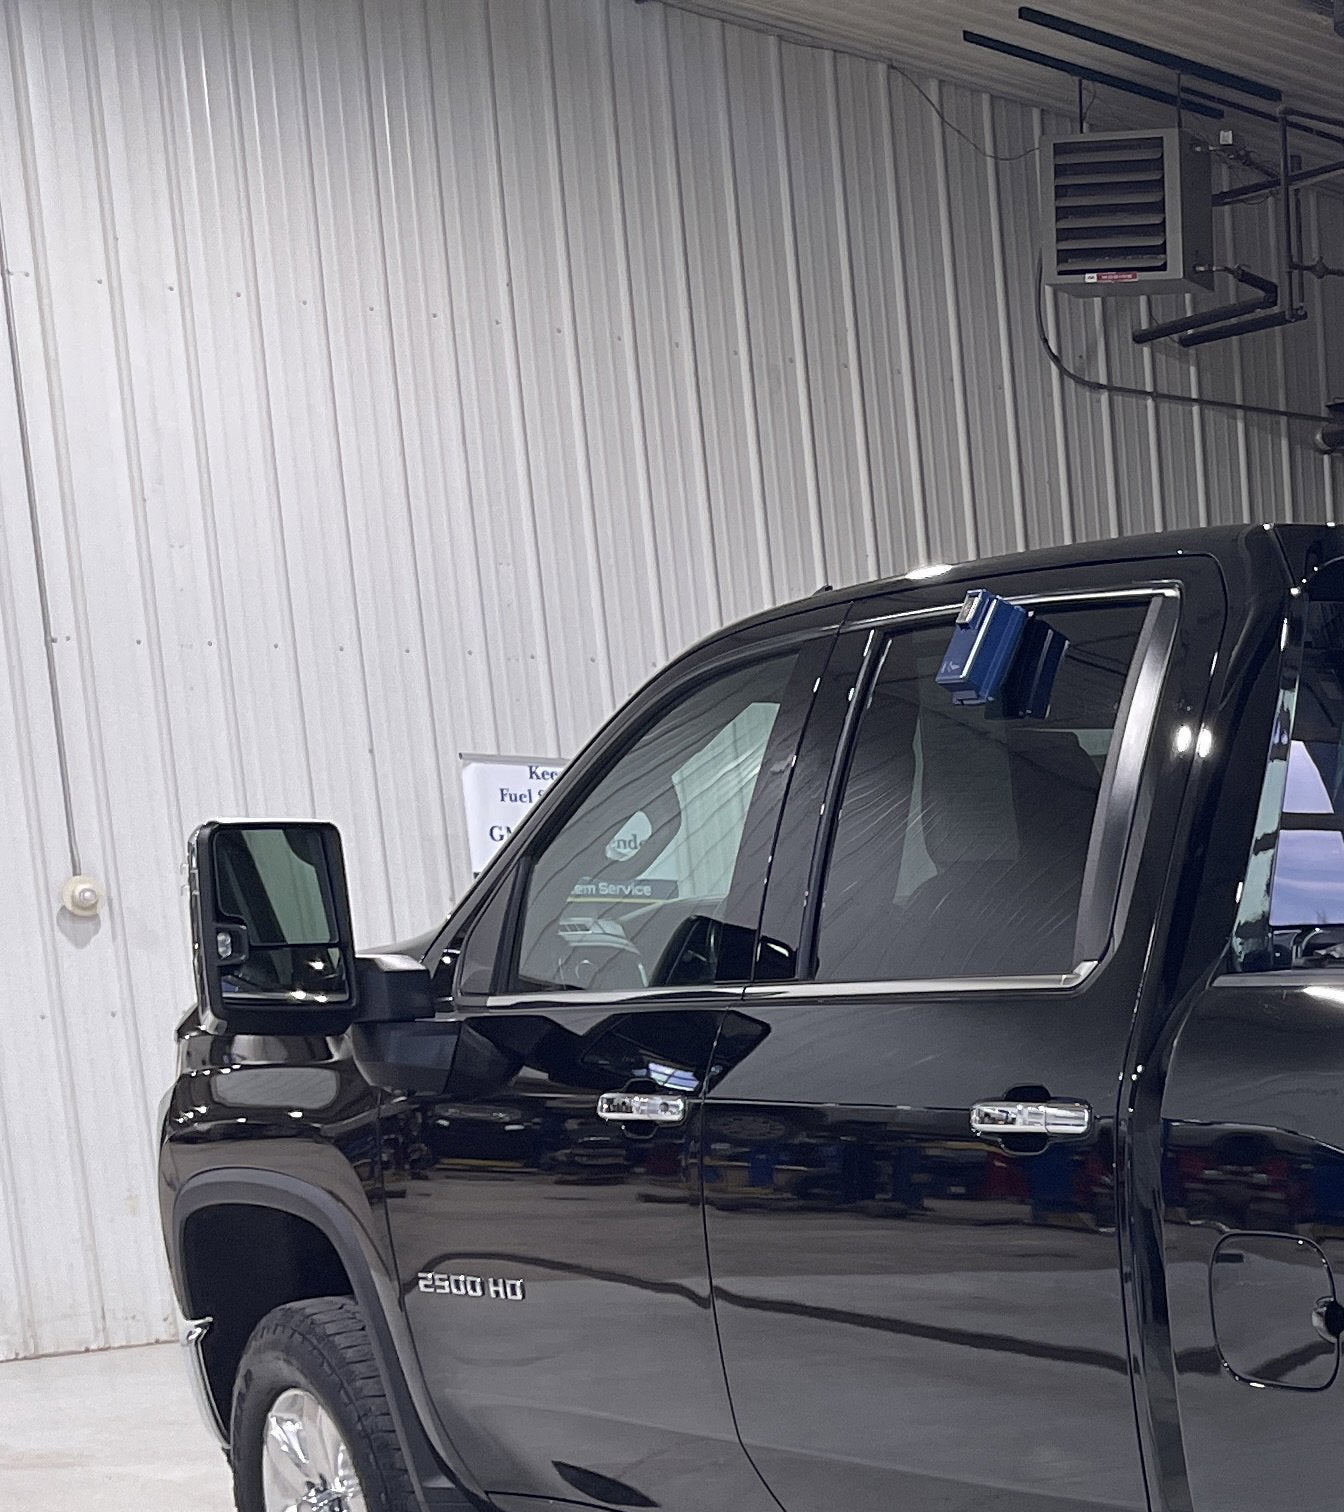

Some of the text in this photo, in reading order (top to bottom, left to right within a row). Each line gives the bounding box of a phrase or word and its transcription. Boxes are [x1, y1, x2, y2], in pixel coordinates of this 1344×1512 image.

[499, 787, 533, 804] Fuel
[599, 882, 652, 897] Service
[417, 1271, 527, 1301] 2500 HD
